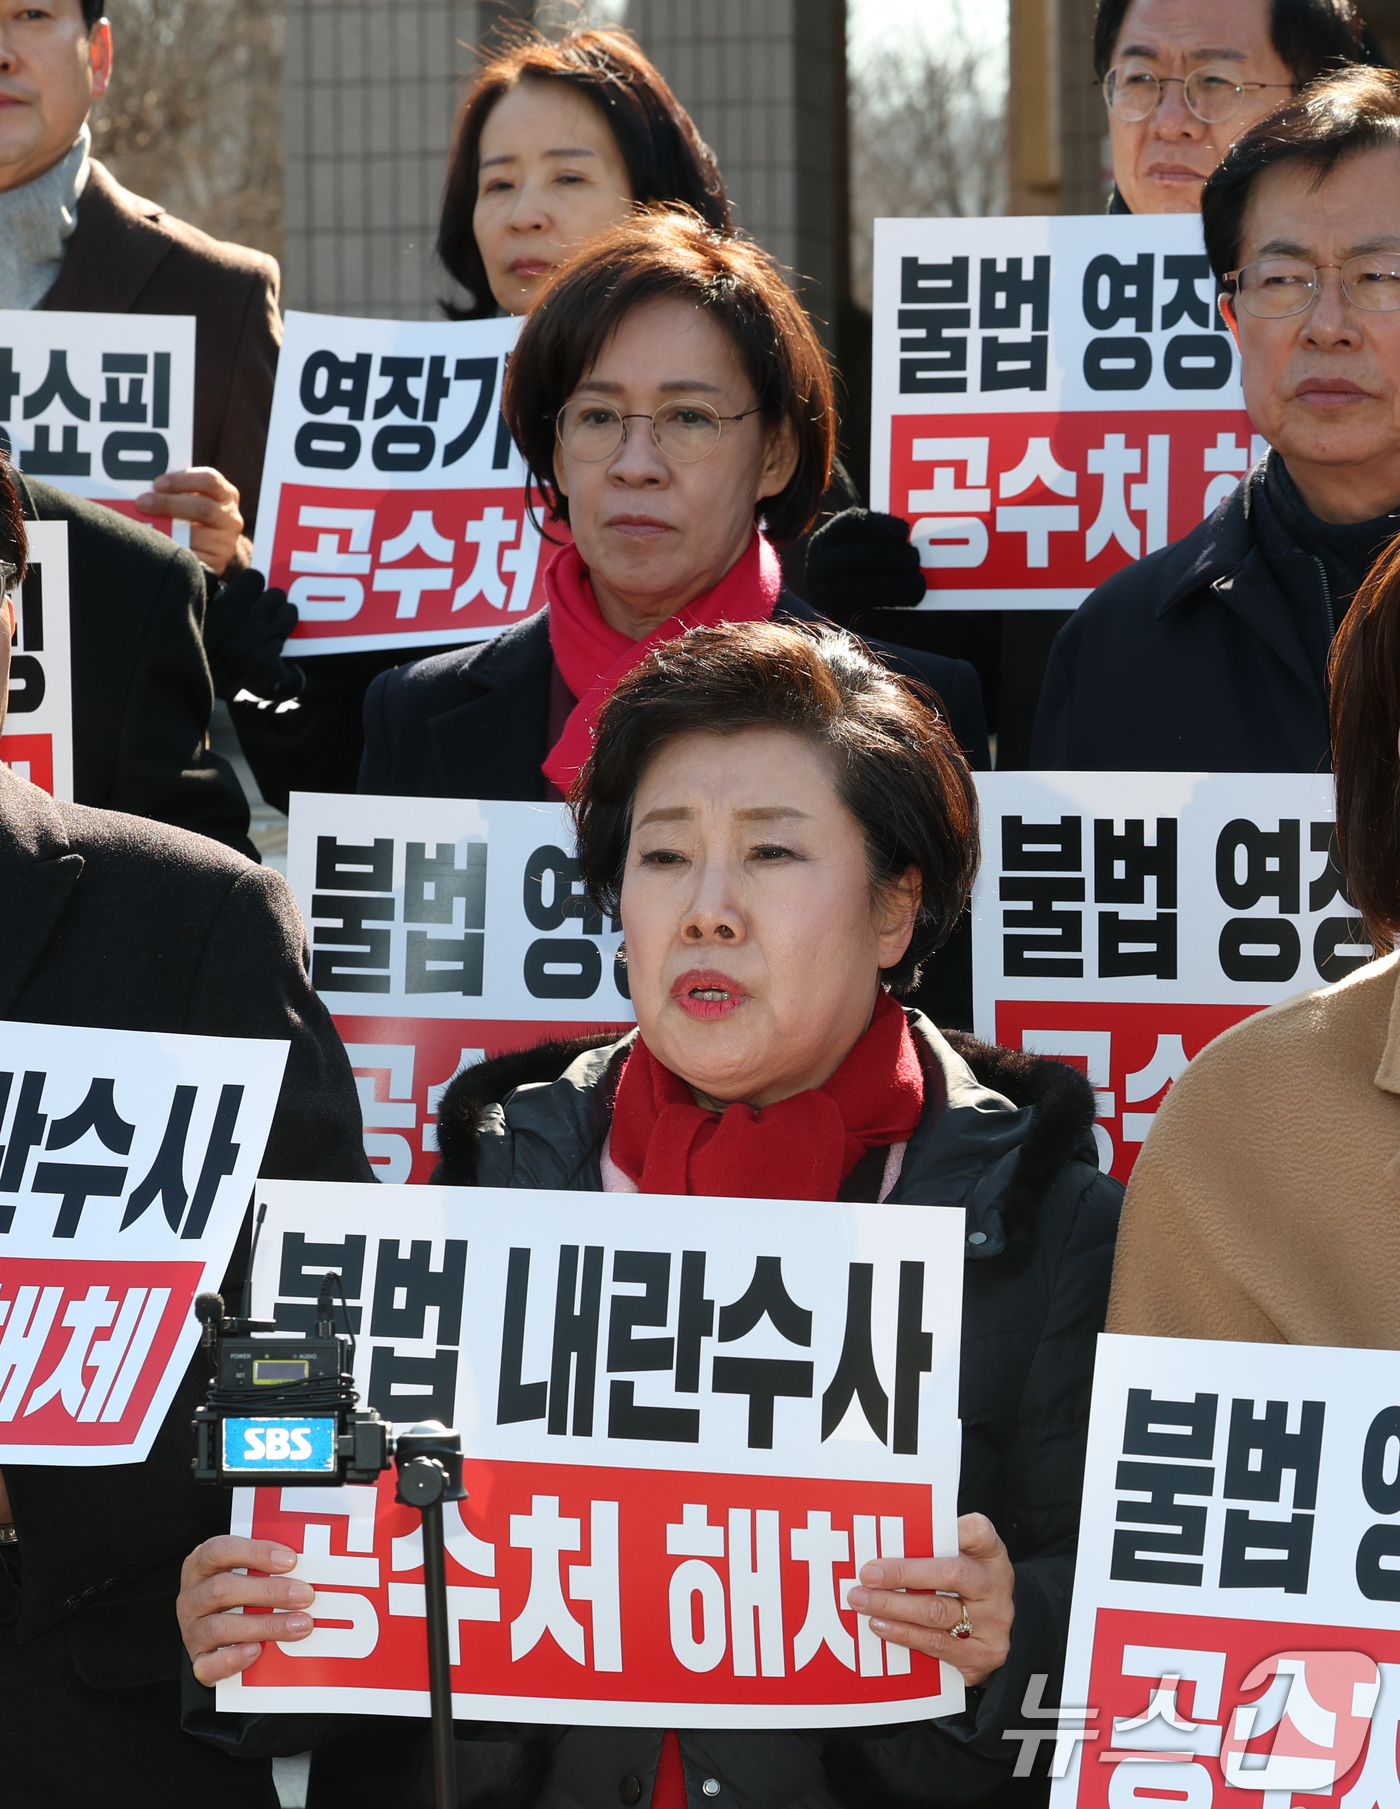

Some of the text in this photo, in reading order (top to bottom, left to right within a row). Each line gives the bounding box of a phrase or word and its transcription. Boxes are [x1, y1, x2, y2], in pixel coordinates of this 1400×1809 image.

[897, 254, 1051, 394] 불법
[287, 505, 545, 622] 공수처
[907, 433, 1170, 569] 공수처
[311, 835, 631, 1000] 불법 영
[998, 815, 1178, 980] 불법
[497, 1244, 933, 1455] 내란수사
[243, 1427, 313, 1461] SBS
[1110, 1388, 1326, 1595] 불법
[666, 1503, 912, 1678] 해체
